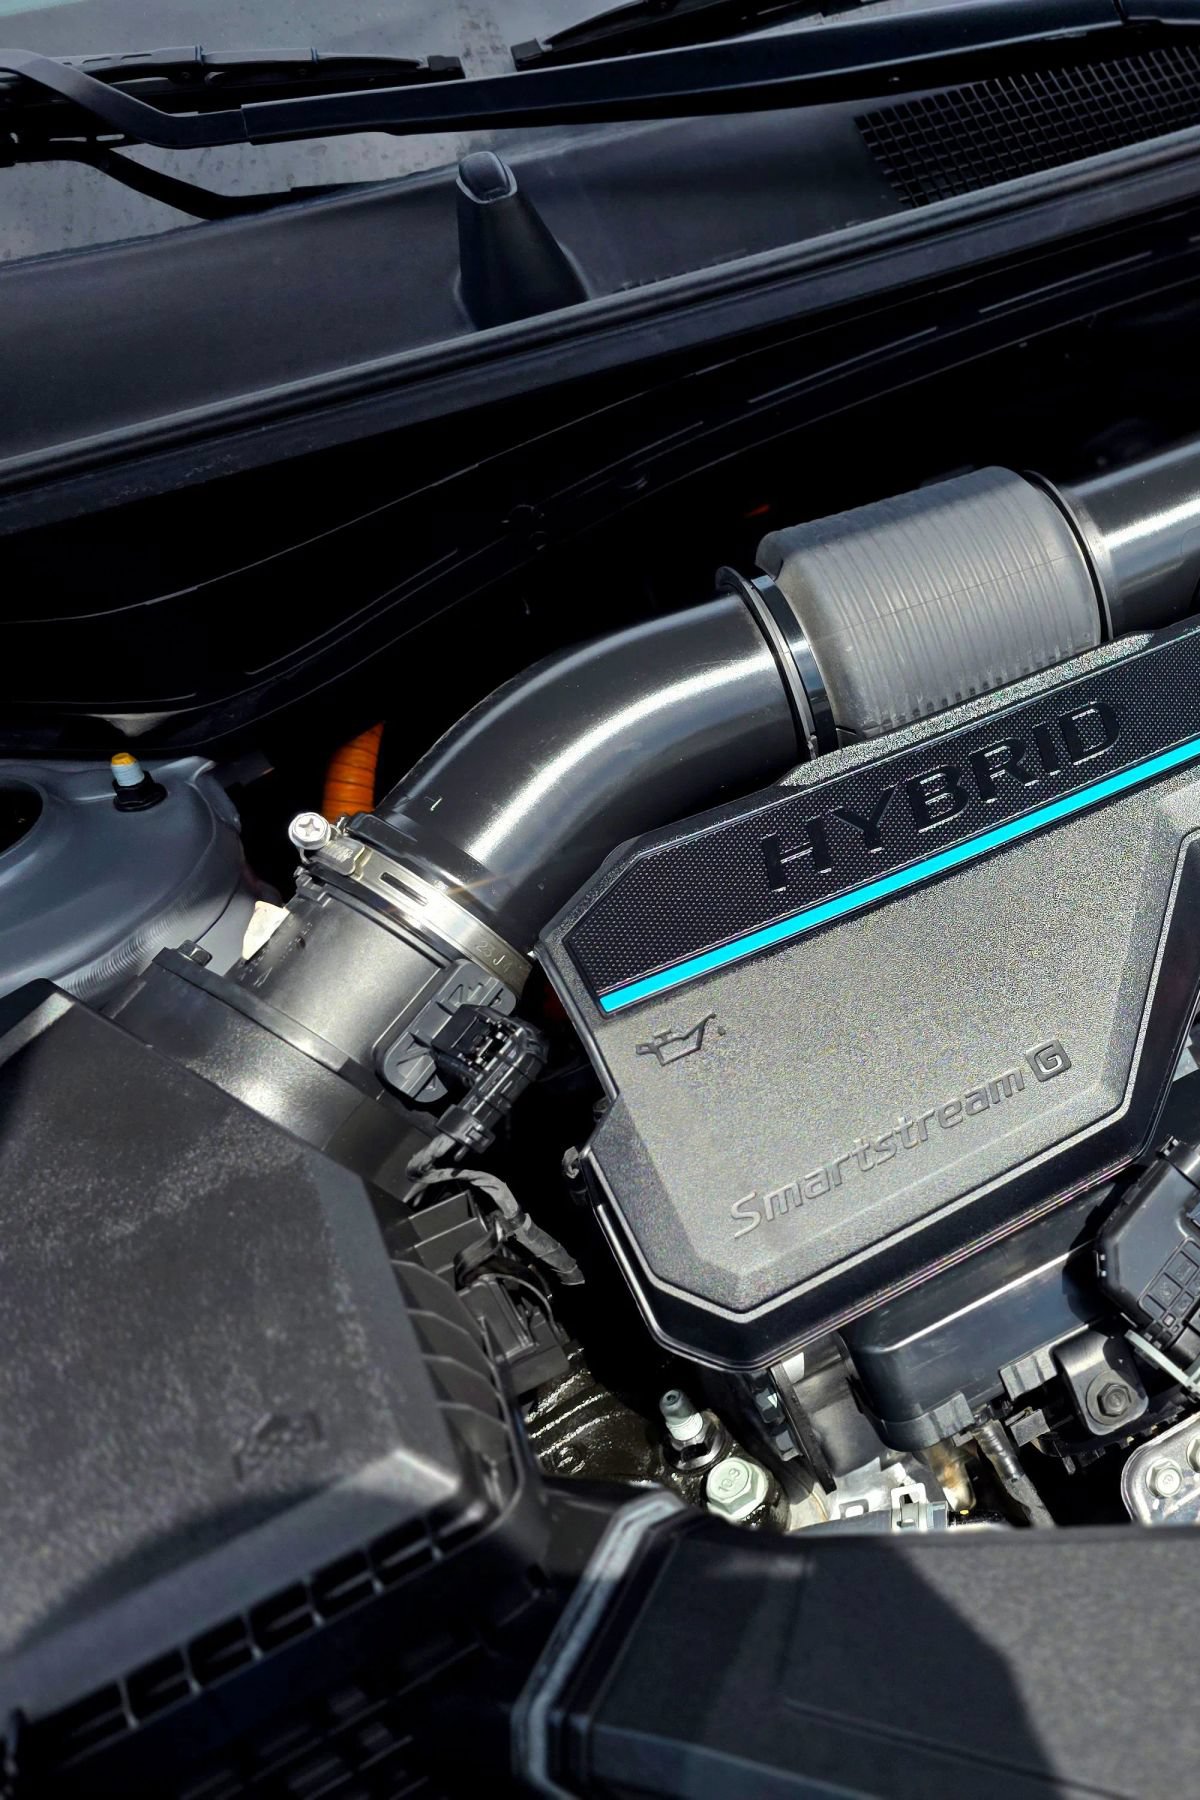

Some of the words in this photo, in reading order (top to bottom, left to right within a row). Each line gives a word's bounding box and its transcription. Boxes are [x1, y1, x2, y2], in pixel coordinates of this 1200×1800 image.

[762, 702, 1121, 891] HYBRID
[731, 1068, 1025, 1239] Smartstream
[1029, 1042, 1068, 1079] G
